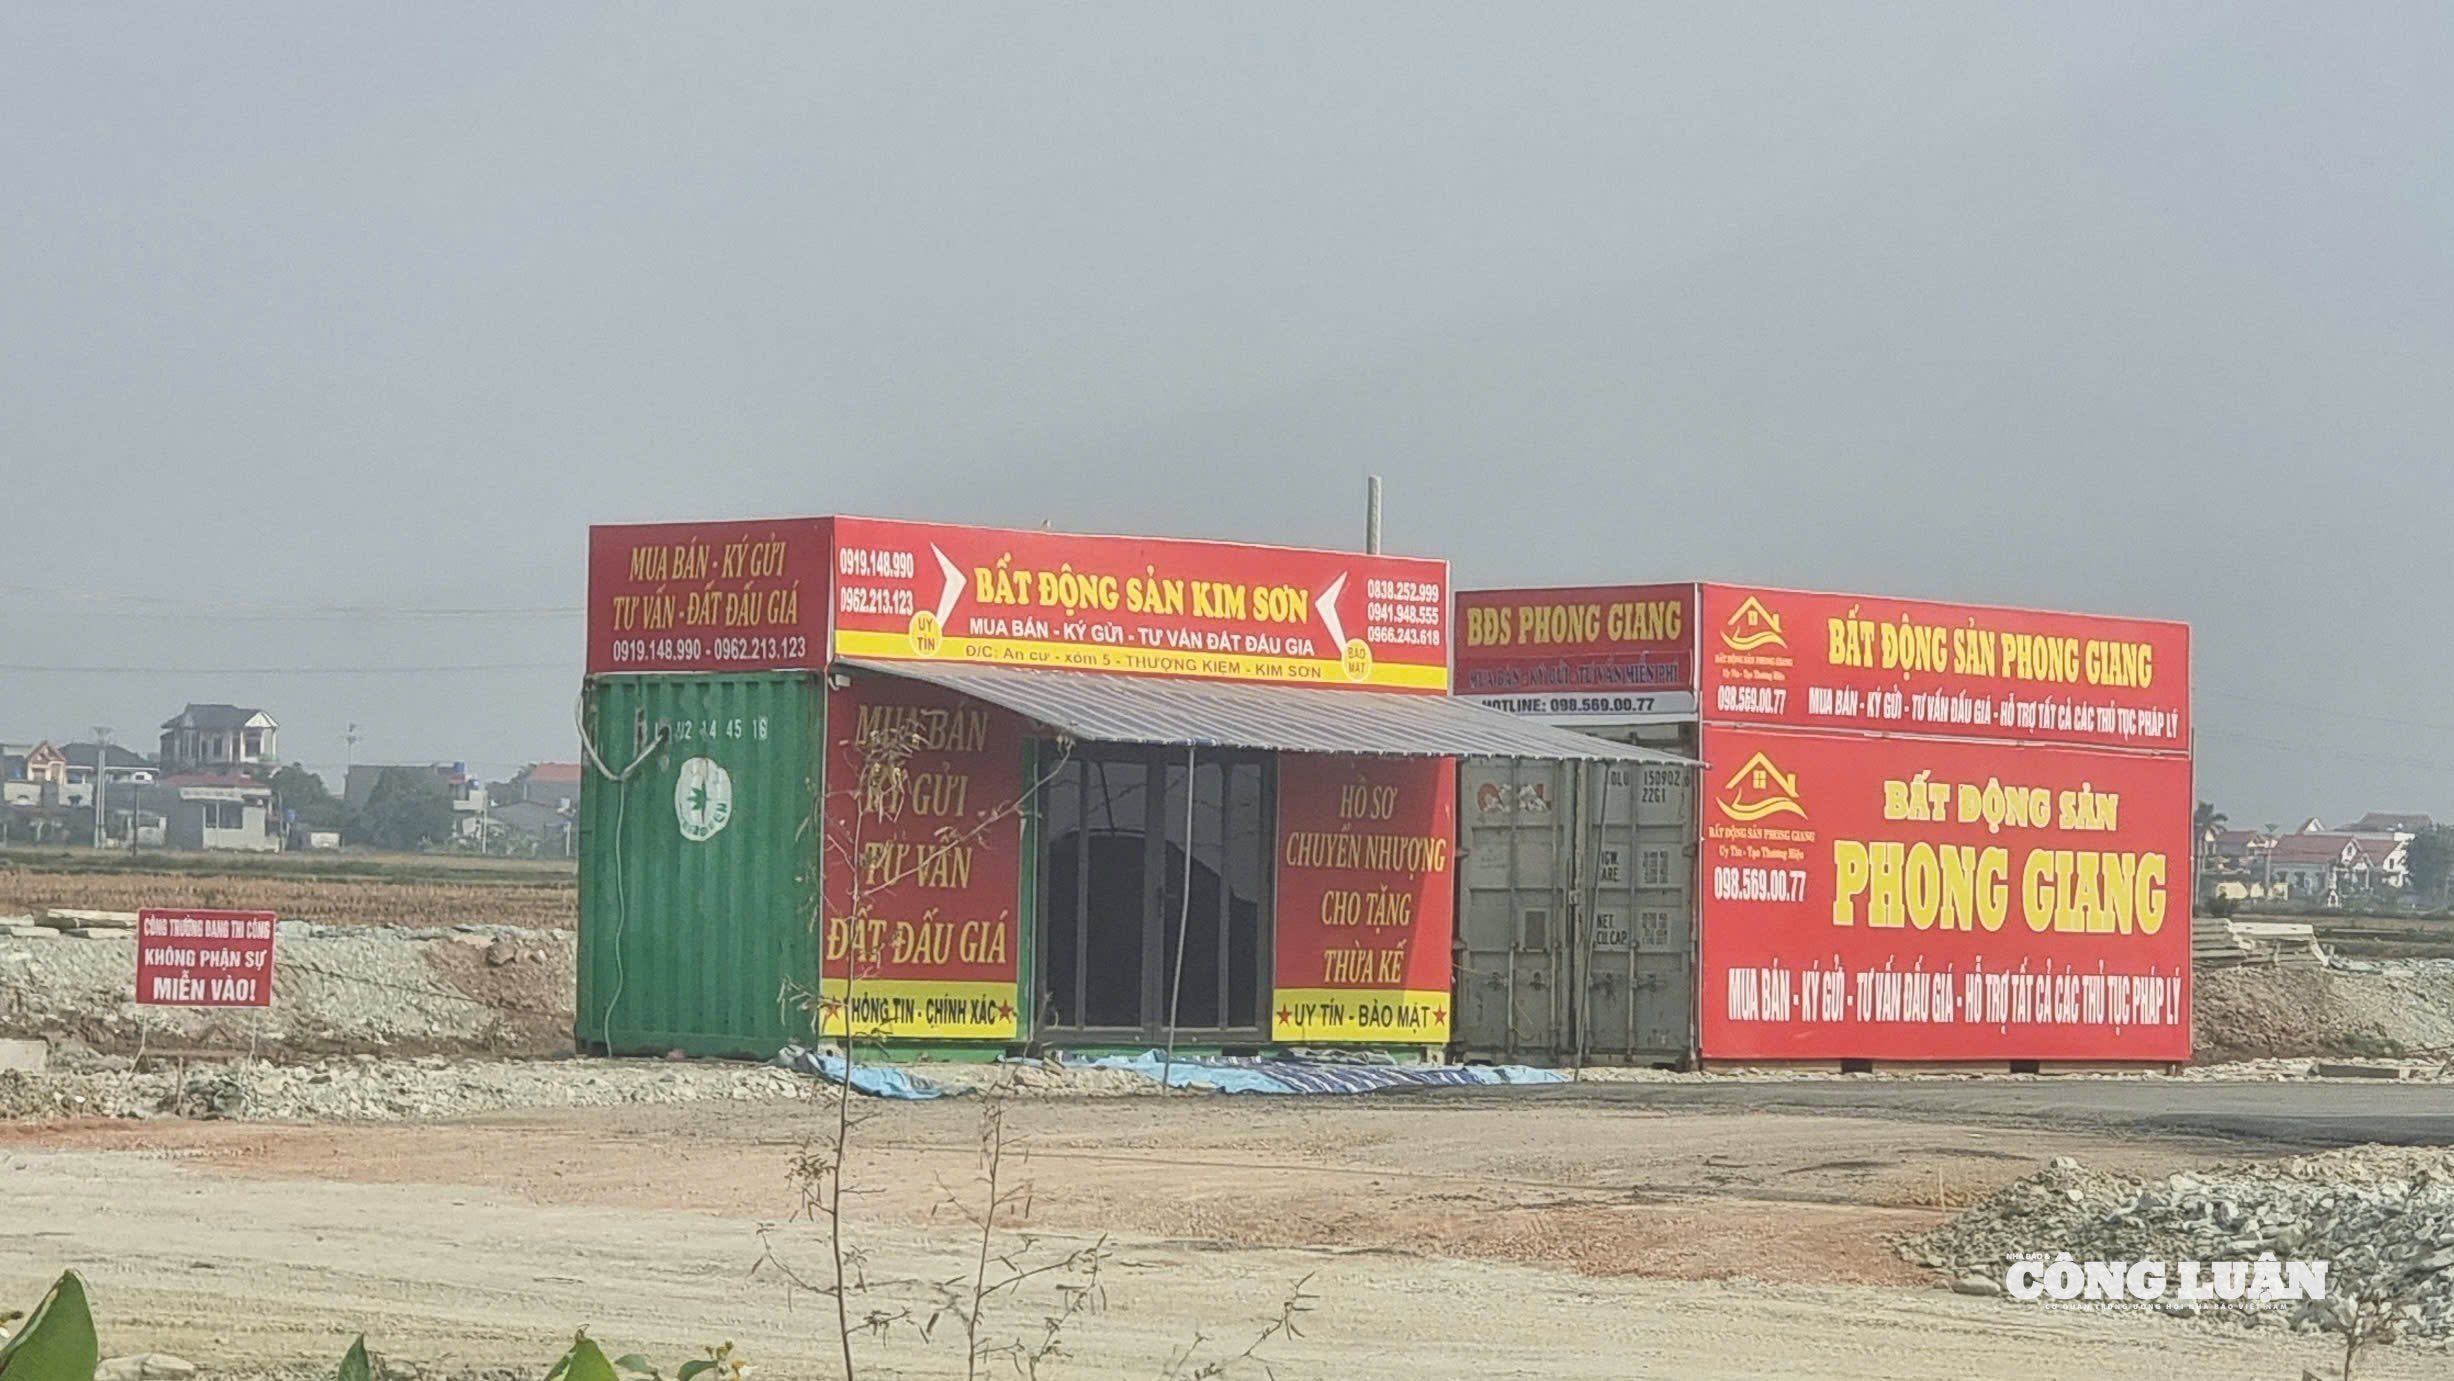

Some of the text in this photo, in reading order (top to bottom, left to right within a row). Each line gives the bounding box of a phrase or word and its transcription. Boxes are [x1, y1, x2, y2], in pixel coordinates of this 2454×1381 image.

[629, 532, 786, 581] MUA BÁN KÝ GỬI
[840, 548, 914, 578] 0919.148.990
[840, 586, 913, 616] 0962.213.123
[974, 552, 1309, 624] BẤT ĐỘNG SẢN KIM SƠN
[1367, 578, 1439, 603] 0838.252.999
[614, 596, 639, 630] TƯ
[687, 580, 722, 625] ĐẤT
[725, 580, 763, 626] ĐẤU
[768, 580, 799, 624] GIÁ
[1367, 602, 1439, 625] 0941.948.555
[918, 618, 933, 632] UY
[970, 618, 1008, 636] MUA
[1012, 616, 1048, 638] BÁN
[1063, 620, 1088, 641] KÝ
[1091, 622, 1123, 644] GỬI
[1138, 628, 1163, 646] TƯ
[1367, 626, 1440, 646] 0966.243.618
[1518, 605, 1600, 644] PHONG
[1608, 601, 1681, 641] GIANG
[613, 636, 806, 661] 0919.148.990 0962.213.123
[1827, 604, 2153, 688] BẤT ĐỘNG SẢN PHONG GIANG
[1003, 648, 1024, 660] An
[1102, 654, 1111, 665] 5
[1256, 663, 1283, 676] KIM
[1288, 665, 1321, 678] SƠN
[1550, 698, 1655, 712] 098.569.00.77
[1718, 685, 1787, 715] 098.569.00.77
[1808, 687, 1832, 715] MUA
[1835, 684, 1858, 716] BÁN
[1867, 686, 1882, 718] KÝ
[1912, 692, 1926, 720] TƯ
[1974, 694, 1991, 724] GIÁ
[2016, 701, 2036, 734] TRỢ
[2074, 701, 2095, 732] CÁC
[2117, 707, 2136, 741] TỤC
[2138, 706, 2164, 736] PHÁP
[2166, 708, 2179, 738] LÝ
[726, 719, 741, 739] 45
[1370, 785, 1398, 820] SƠ
[1884, 769, 1950, 822] BẤT
[2059, 782, 2119, 831] SẢN
[1365, 835, 1447, 880] NHƯỢNG
[1714, 866, 1807, 902] 098.569.00.77
[1833, 840, 2167, 935] PHONG GIANG
[1322, 885, 1411, 934] CHO TẶNG
[231, 920, 245, 938] THI
[892, 907, 954, 965] ĐẤU
[960, 909, 1008, 964] GIÁ
[145, 945, 267, 971] KHÔNG PHẬN SỰ
[1324, 938, 1407, 983] THỪA KẾ
[154, 970, 256, 1001] MIỄN VÀO!
[1728, 968, 1759, 1020] MUA
[1761, 957, 1790, 1021] BÁN
[1802, 960, 1820, 1022] KÝ
[1856, 967, 1874, 1022] TƯ
[1875, 954, 1901, 1022] VẤN
[1932, 962, 1954, 1022] GIÁ
[1985, 969, 2010, 1035] TRỢ
[2011, 956, 2034, 1024] TẤT
[2054, 964, 2080, 1024] CÁC
[2107, 975, 2130, 1036] TỤC
[2132, 966, 2164, 1024] PHÁP
[2166, 966, 2182, 1024] LÝ
[893, 993, 996, 1024] TIN CHÍNH XÁC
[1295, 1004, 1316, 1026] UY
[1321, 998, 1344, 1026] TÍN
[1359, 999, 1392, 1028] BẢO
